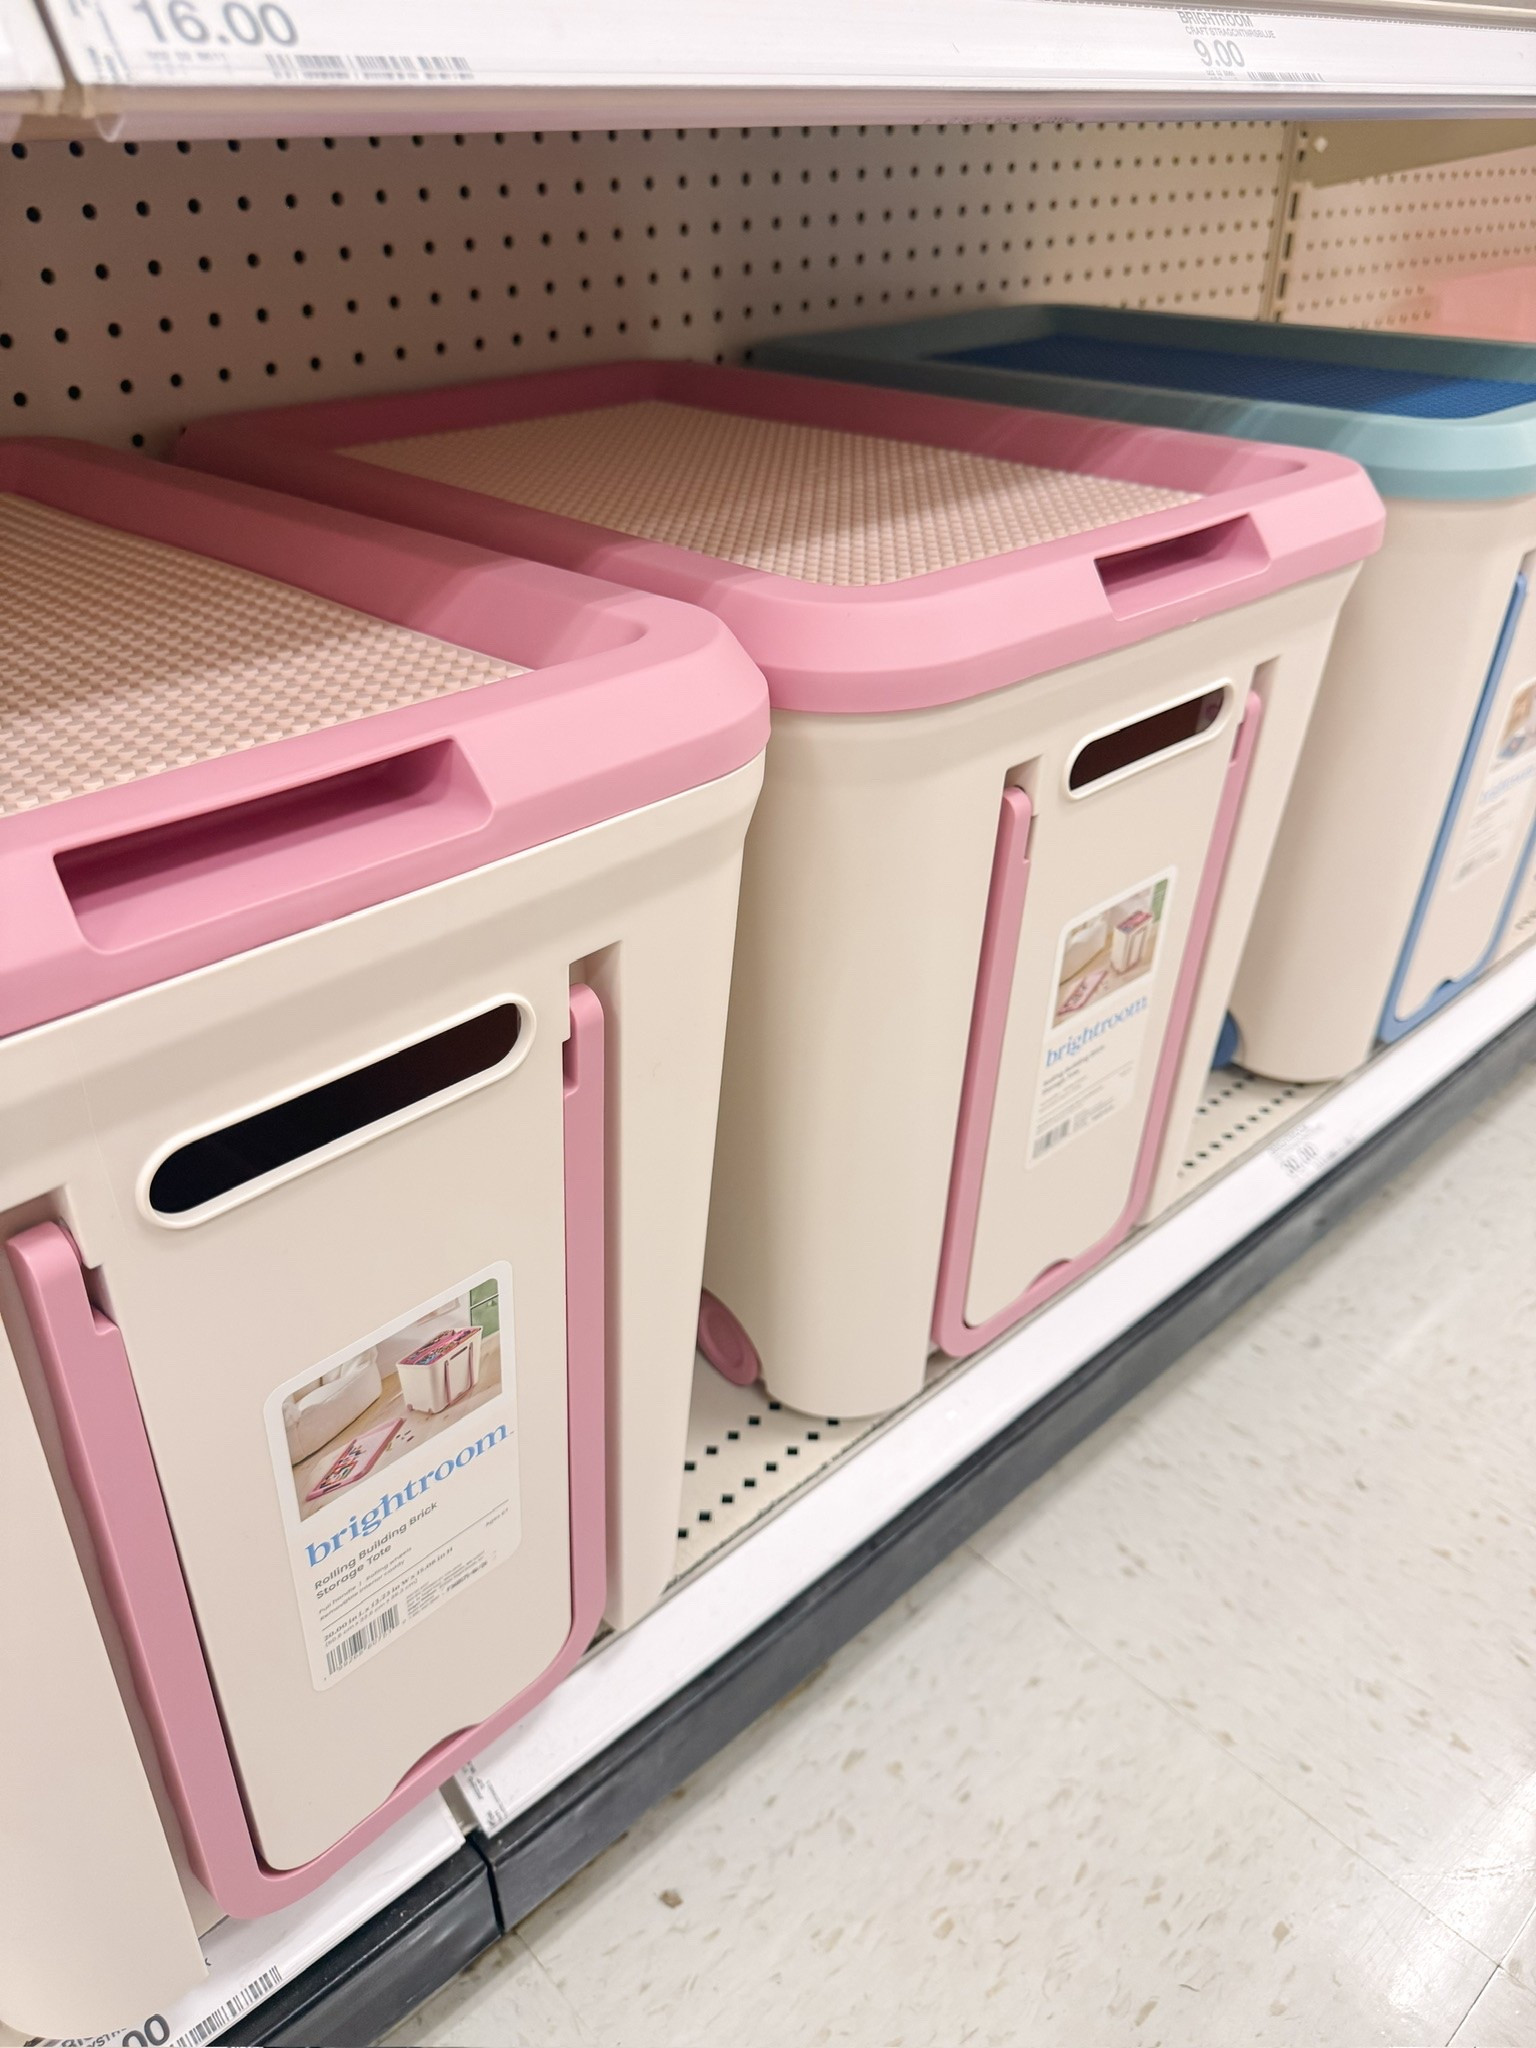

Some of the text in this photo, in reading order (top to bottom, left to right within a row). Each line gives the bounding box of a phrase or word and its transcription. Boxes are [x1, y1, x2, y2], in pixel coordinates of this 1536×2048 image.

[132, 0, 298, 46] 16.00
[1177, 11, 1254, 27] BRIGHTROOM
[1193, 39, 1245, 67] 9.00
[1045, 996, 1148, 1068] brightroom
[305, 1424, 508, 1568] brightroom
[315, 1502, 438, 1590] Rolling Building Brick
[317, 1544, 392, 1599] Storage Tote
